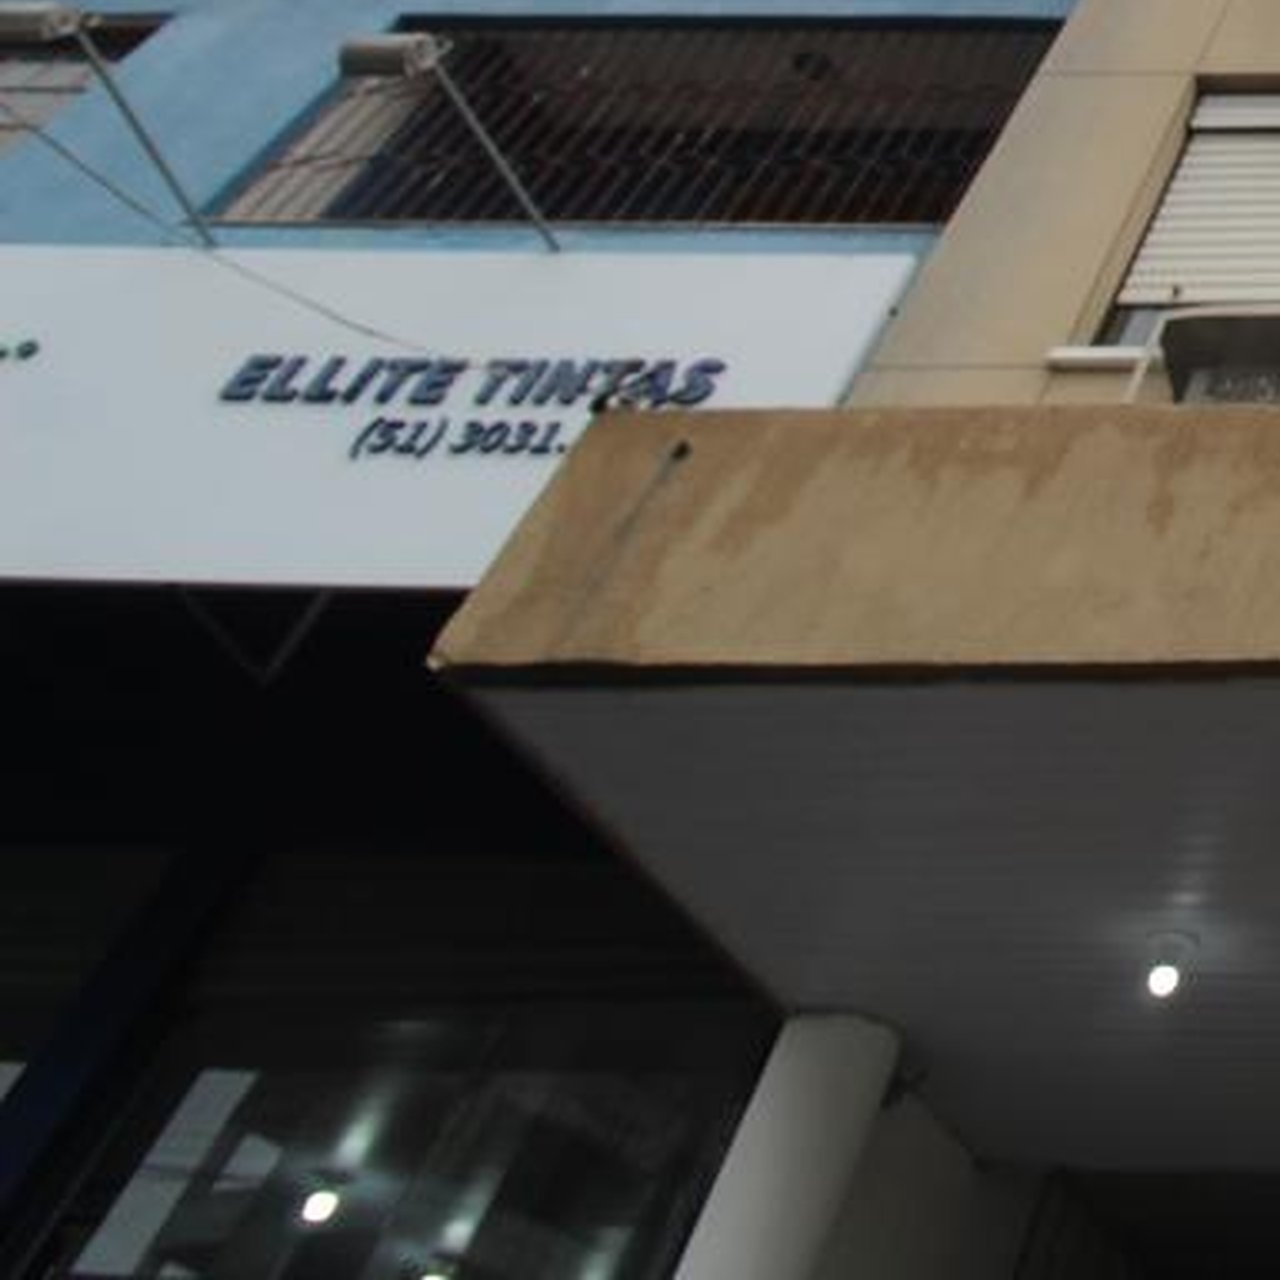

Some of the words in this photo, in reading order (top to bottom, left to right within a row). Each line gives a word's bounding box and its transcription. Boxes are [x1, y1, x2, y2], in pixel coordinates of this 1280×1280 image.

[219, 355, 467, 406] ELLITE
[474, 358, 727, 410] TINTAS
[350, 418, 449, 460] (51)
